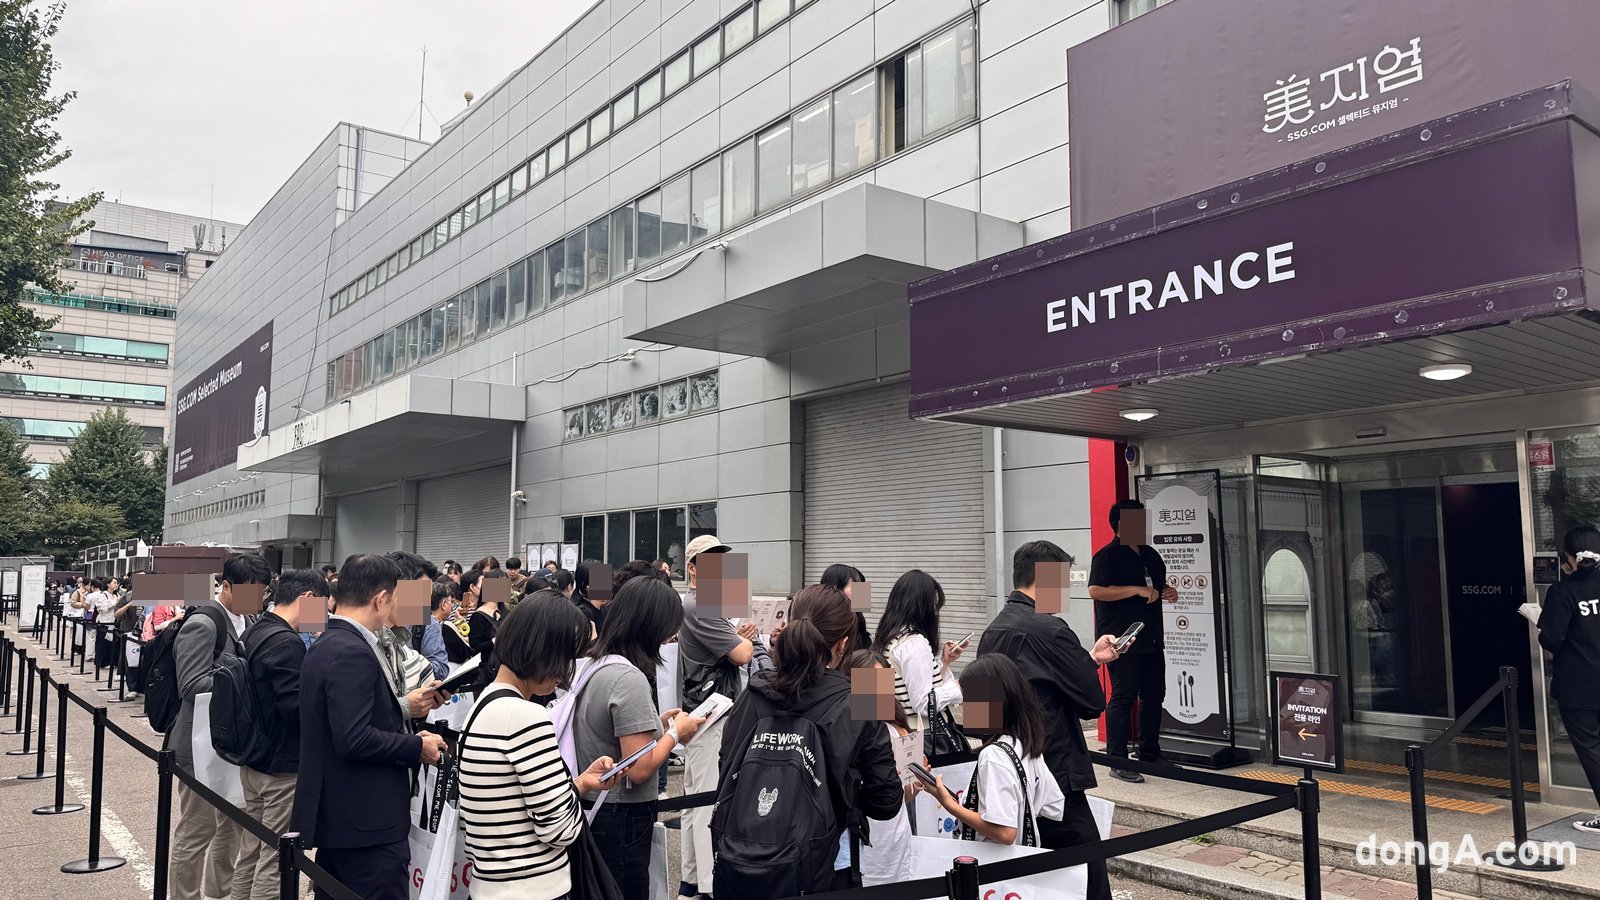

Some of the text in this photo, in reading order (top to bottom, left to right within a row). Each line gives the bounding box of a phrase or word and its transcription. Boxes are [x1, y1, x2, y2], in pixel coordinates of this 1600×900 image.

[1287, 98, 1398, 142] SSG.COM 셀렉티드 뮤지엄
[92, 249, 115, 258] HEAD
[117, 253, 145, 262] OFFICE
[1047, 241, 1296, 333] ENTRANCE
[177, 361, 243, 415] SSG.COM Selected Museum
[1462, 585, 1501, 595] SSG.COM
[1287, 703, 1327, 715] INVITATION
[1294, 713, 1321, 724] 전용 라인
[435, 769, 443, 798] SSG.COM
